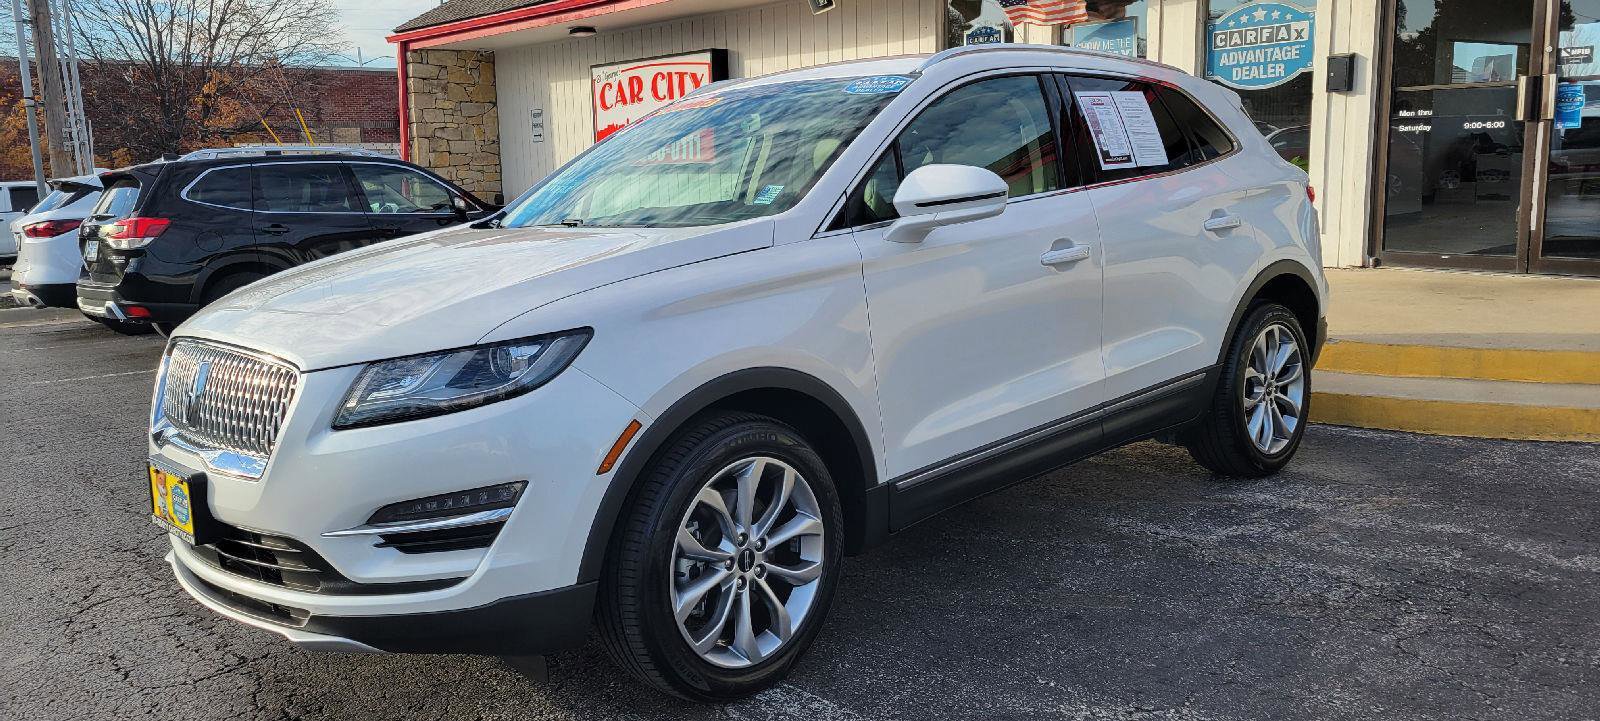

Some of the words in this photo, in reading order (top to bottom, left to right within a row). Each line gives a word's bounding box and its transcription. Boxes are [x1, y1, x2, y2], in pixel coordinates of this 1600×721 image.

[1102, 39, 1115, 51] ME
[1116, 37, 1131, 49] THE
[1215, 25, 1306, 47] CARFAX
[1220, 45, 1300, 66] ADVANTAGE
[1232, 63, 1285, 81] DEALER
[599, 75, 644, 112] CAR
[651, 71, 705, 102] CITY
[1399, 123, 1432, 132] Saturday
[1463, 121, 1505, 130] 9:00-6:00
